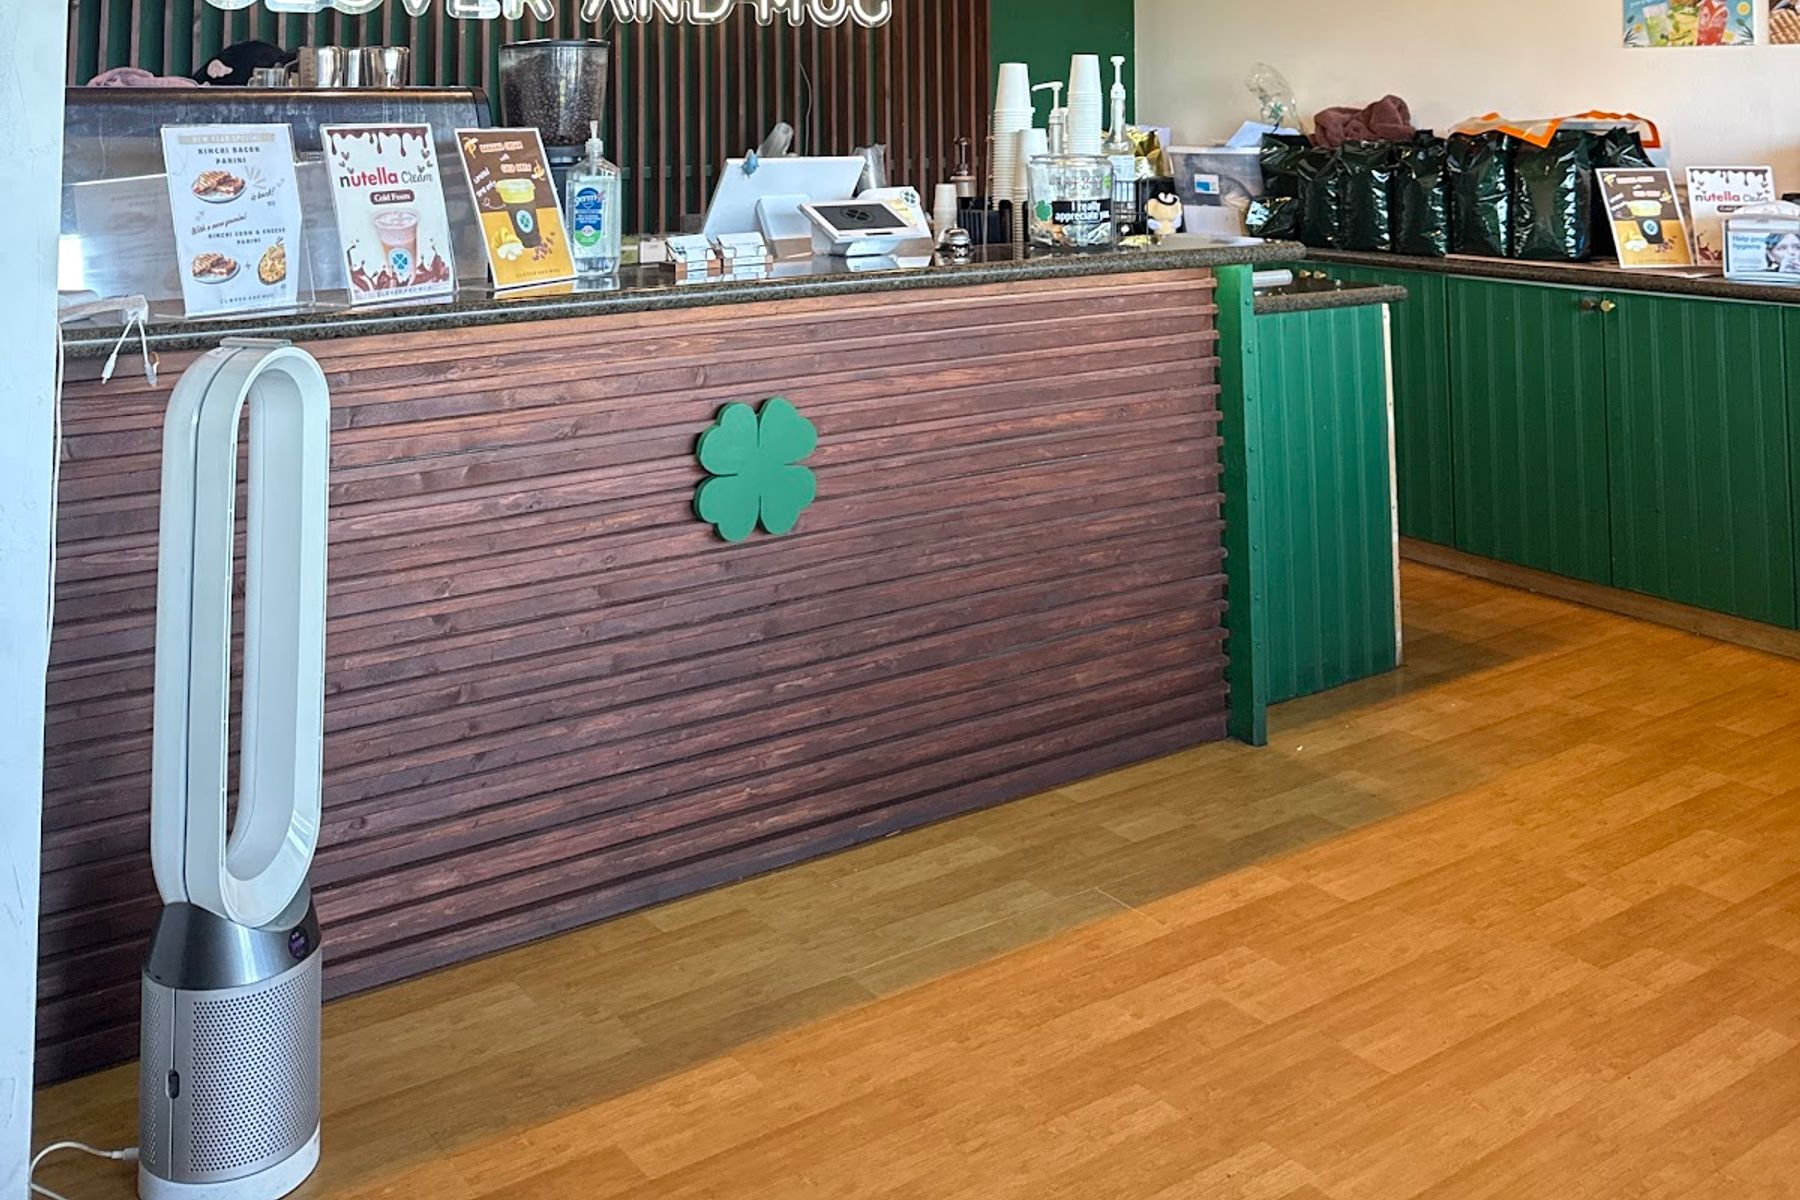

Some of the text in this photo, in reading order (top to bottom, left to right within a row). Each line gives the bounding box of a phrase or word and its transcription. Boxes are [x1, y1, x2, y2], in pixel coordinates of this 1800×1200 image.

[198, 146, 260, 155] KIMCHI BACON
[340, 167, 433, 188] nutella Cream
[1695, 191, 1740, 202] nutella
